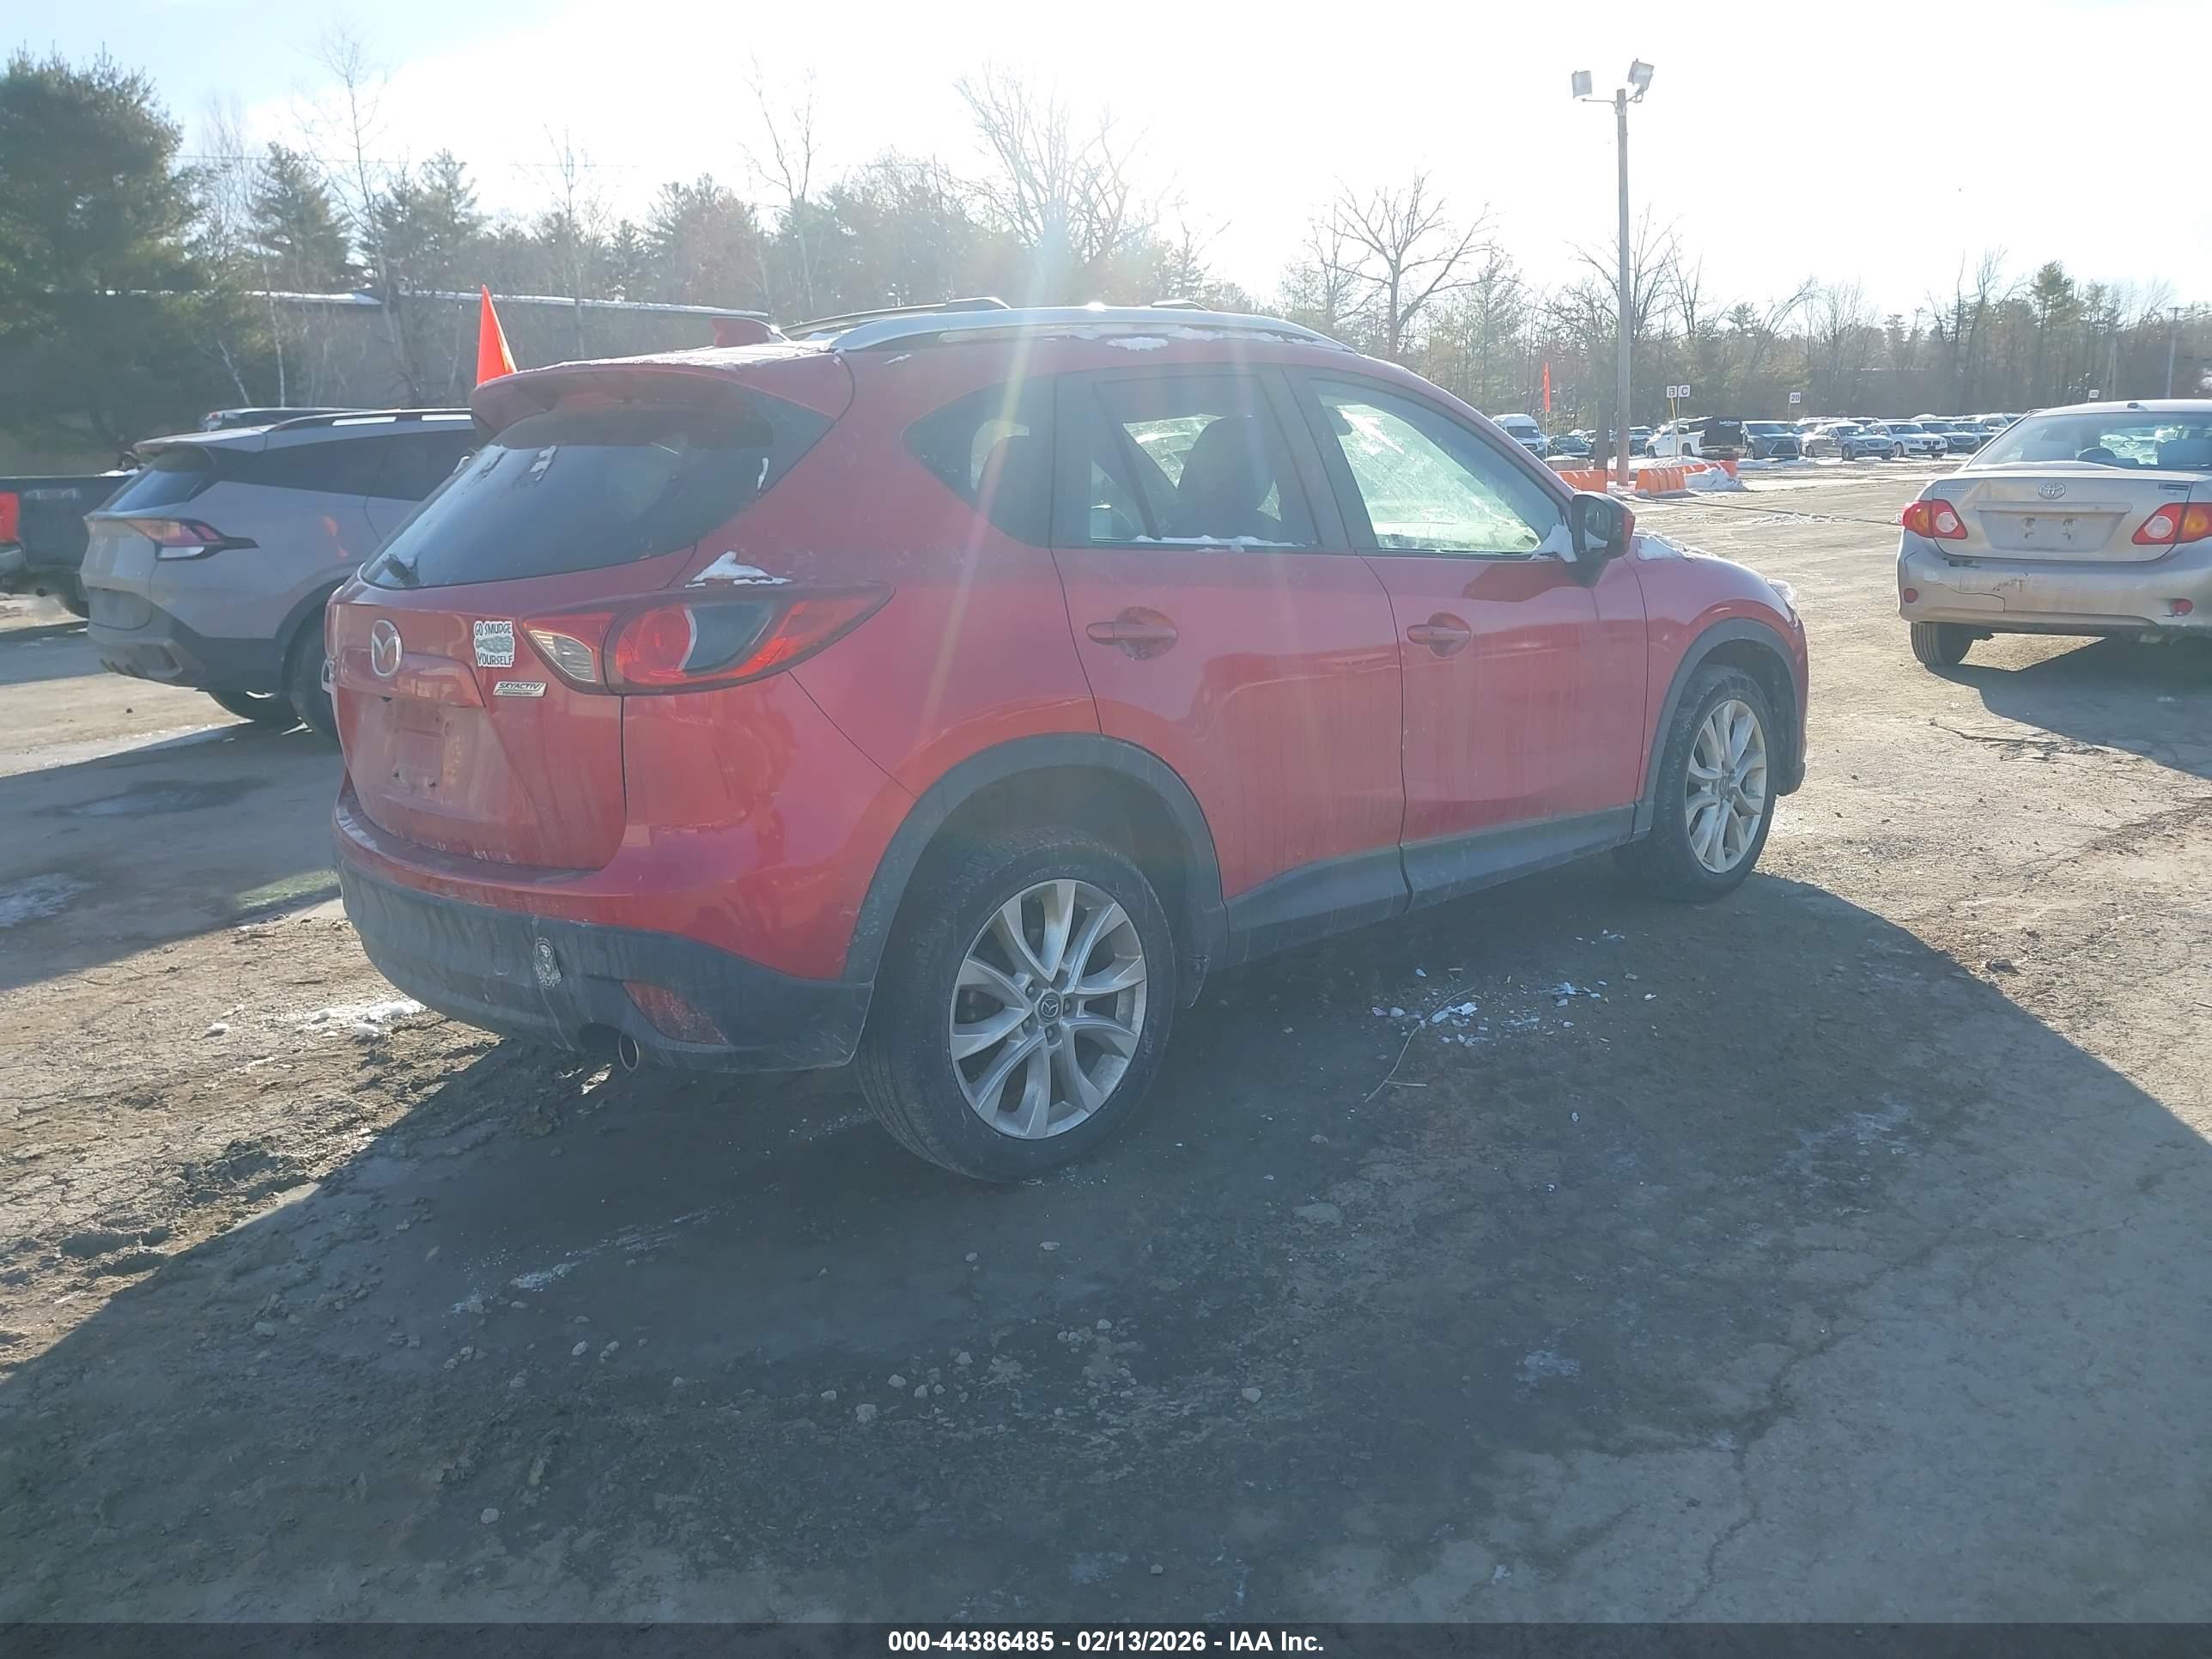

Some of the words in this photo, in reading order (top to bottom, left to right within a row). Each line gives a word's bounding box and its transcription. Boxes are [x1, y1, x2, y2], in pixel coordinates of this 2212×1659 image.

[1681, 386, 1688, 396] C
[476, 623, 483, 635] GO
[484, 623, 512, 635] SMUDGE
[477, 652, 513, 665] YOURSELF
